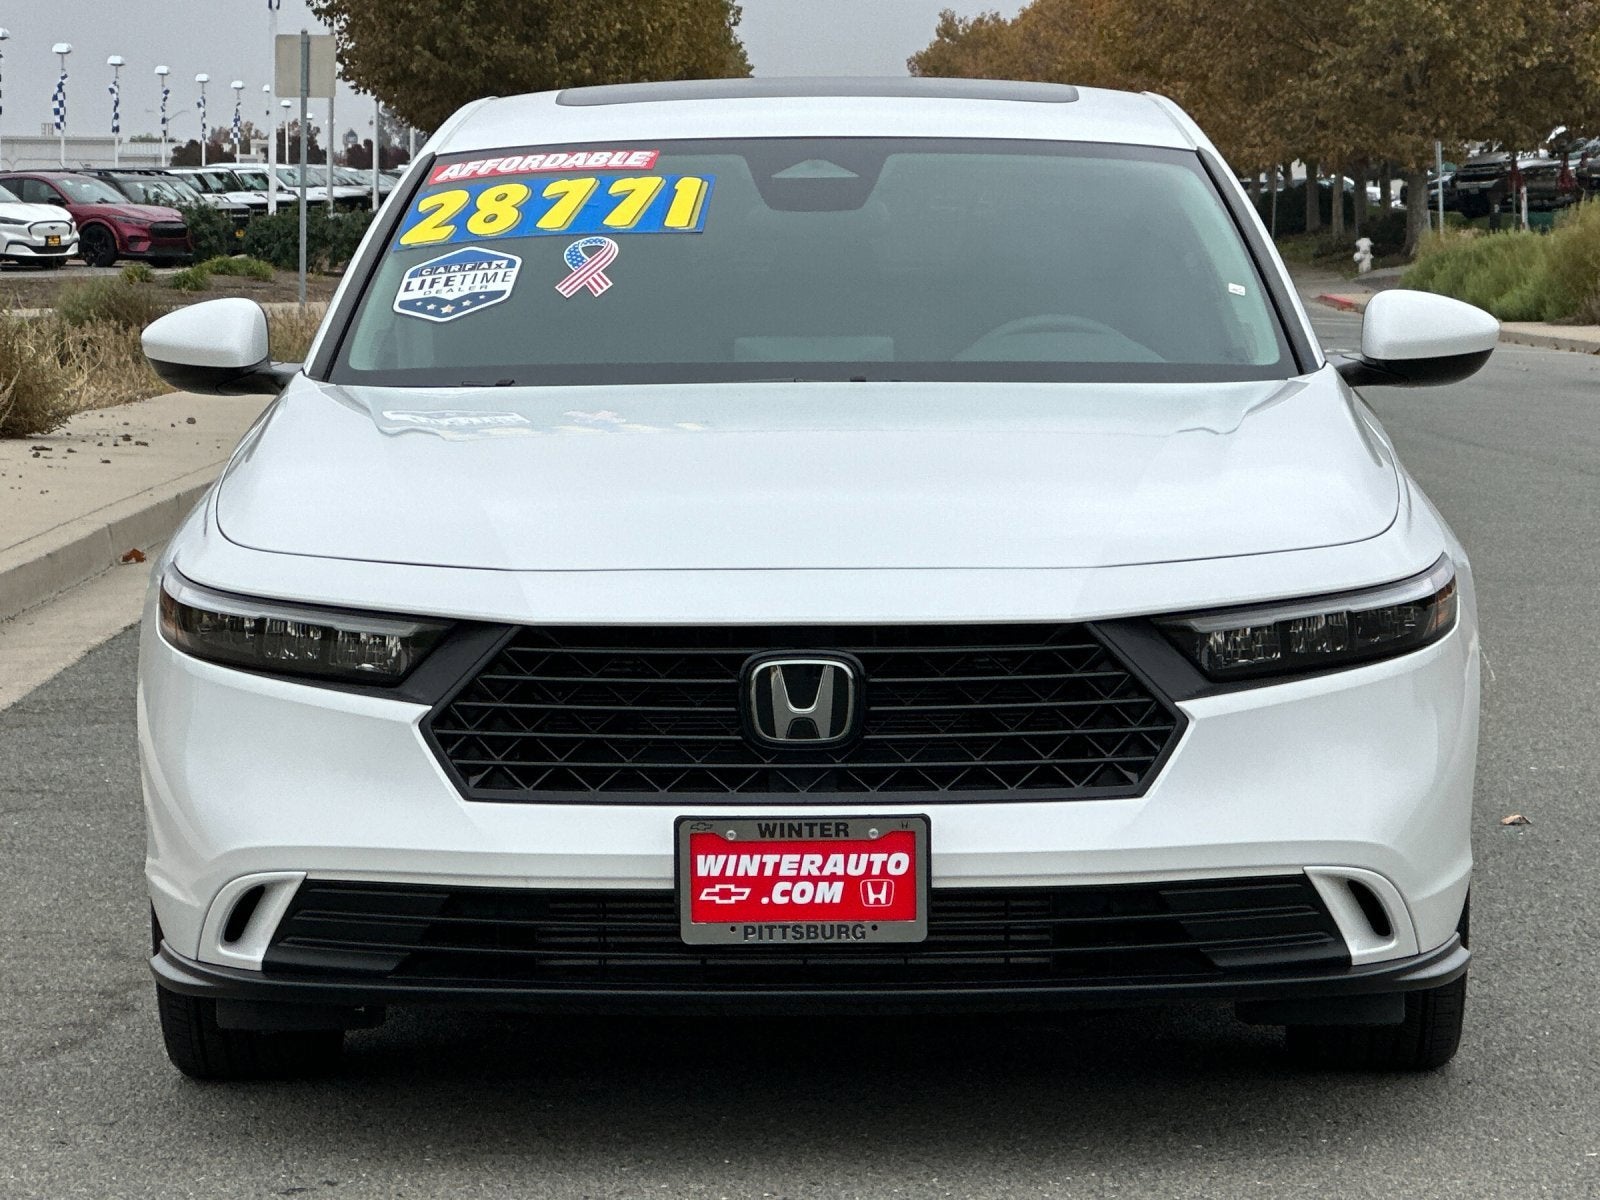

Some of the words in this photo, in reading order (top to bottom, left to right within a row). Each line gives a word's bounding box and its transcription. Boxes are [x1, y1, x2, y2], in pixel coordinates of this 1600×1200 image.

[434, 150, 656, 183] AFFORDABLE
[399, 176, 709, 247] 28771
[419, 260, 508, 277] CARFAX
[403, 270, 514, 293] LIFETIME
[423, 285, 488, 296] DEALER
[757, 822, 849, 839] WINTER
[696, 852, 910, 877] WINTERAUTO
[760, 881, 844, 905] .COM
[743, 923, 867, 942] PITTSBURG
